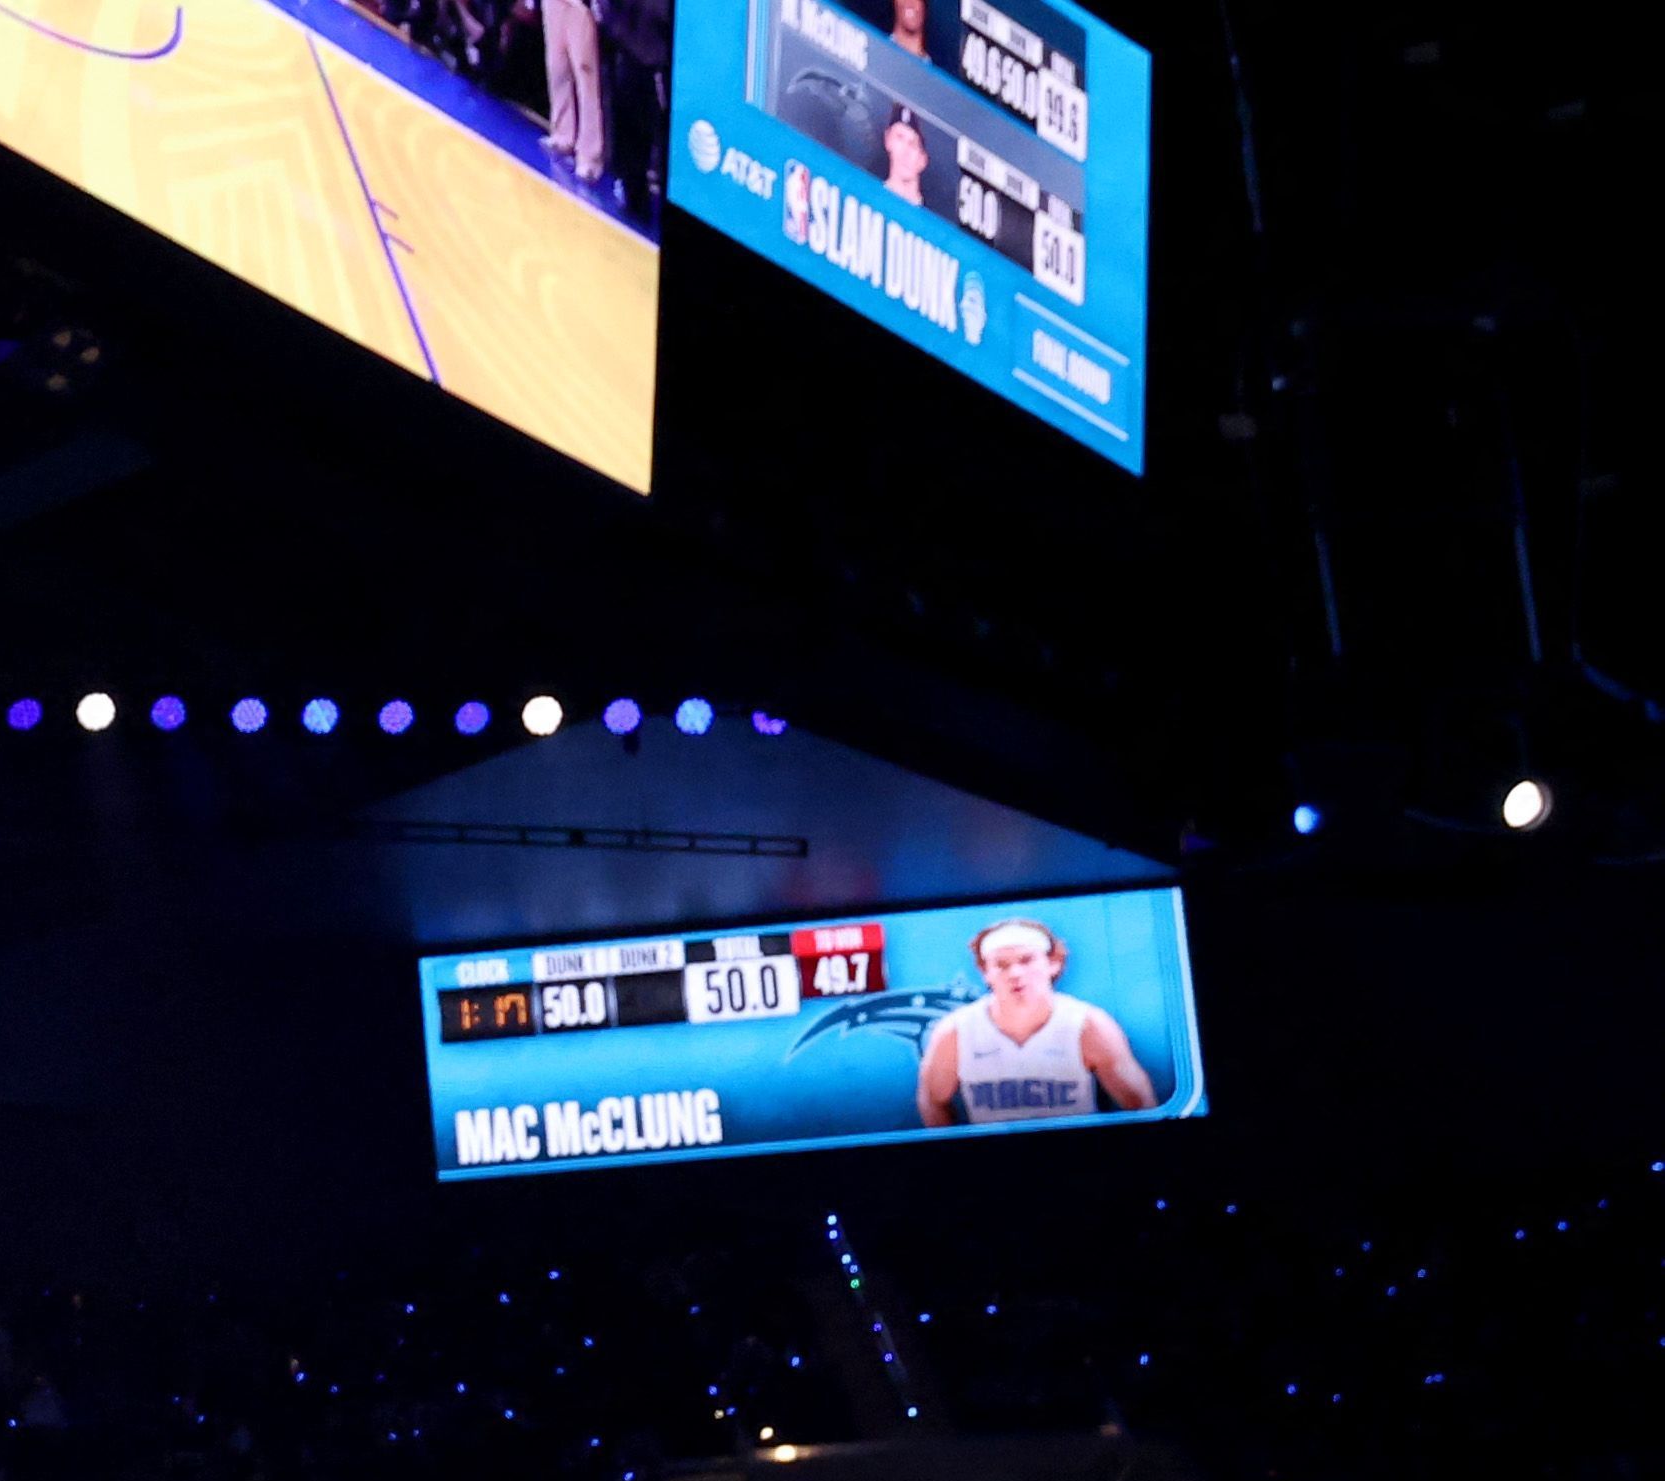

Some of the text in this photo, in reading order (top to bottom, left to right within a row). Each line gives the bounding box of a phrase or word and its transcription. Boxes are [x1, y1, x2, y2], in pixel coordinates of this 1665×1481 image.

[721, 146, 959, 334] AT&T SLAM DUNK
[543, 981, 606, 1029] 50.0
[707, 964, 780, 1014] 50.0
[813, 953, 871, 996] 49.7
[455, 1088, 722, 1166] MAC McCLUNG
